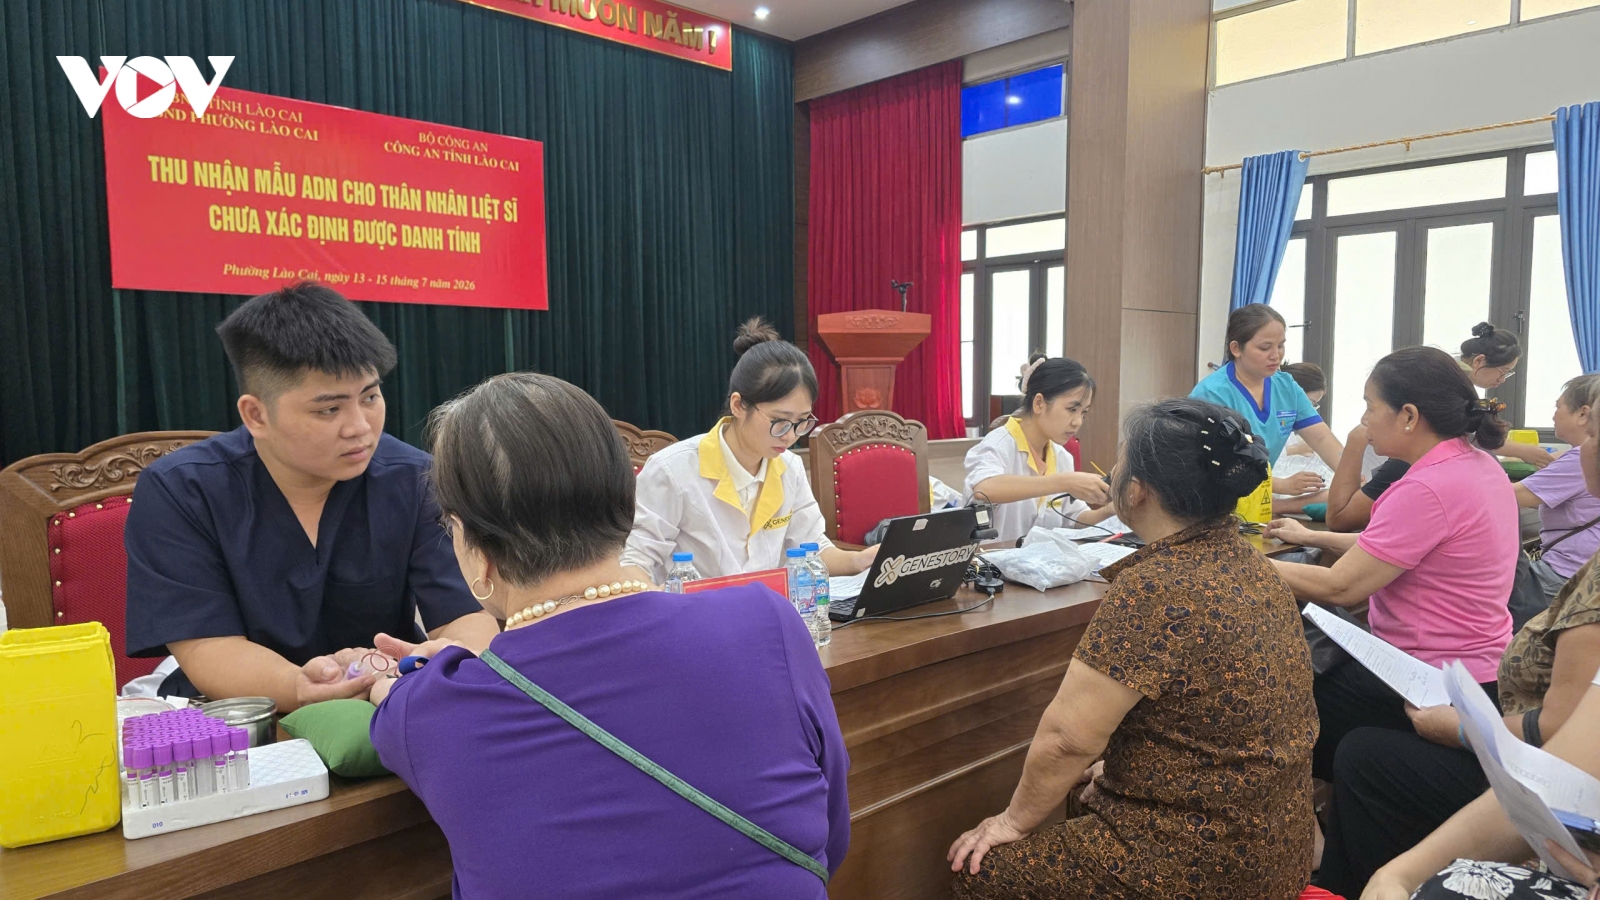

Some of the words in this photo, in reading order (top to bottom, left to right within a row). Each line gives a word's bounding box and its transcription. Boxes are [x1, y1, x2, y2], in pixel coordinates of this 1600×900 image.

[643, 10, 704, 51] NĂM
[246, 102, 276, 119] LÀO
[278, 108, 303, 123] CAI
[260, 121, 291, 137] LÀO
[293, 127, 319, 141] CAI
[418, 131, 436, 145] BỘ
[437, 134, 470, 150] CÔNG
[472, 142, 488, 153] AN
[383, 139, 420, 157] CÔNG
[423, 148, 440, 159] AN
[442, 149, 471, 164] TỈNH
[474, 154, 498, 168] LÀO
[500, 159, 520, 172] CAI
[148, 155, 187, 185] THU
[193, 159, 249, 196] NHẬN
[254, 161, 296, 198] MẪU
[301, 175, 338, 202] ADN
[342, 179, 376, 207] CHO
[380, 182, 422, 212] THÂN
[425, 189, 468, 217] NHÂN
[471, 193, 500, 225] LIỆT
[503, 197, 518, 223] SĨ
[208, 204, 261, 234] CHƯA
[265, 207, 302, 238] XÁC
[307, 213, 349, 246] ĐỊNH
[353, 219, 397, 250] ĐƯỢC
[401, 224, 443, 250] DANH
[447, 226, 481, 254] TÍNH
[223, 263, 270, 280] Phường
[272, 266, 295, 279] Lào
[324, 271, 350, 285] ngày
[353, 272, 366, 284] 13
[376, 274, 388, 285] 15
[390, 275, 419, 289] tháng
[421, 277, 428, 288] 7
[429, 278, 451, 289] năm
[453, 279, 476, 291] 2026
[900, 544, 976, 574] GENESTORY
[152, 821, 163, 829] 010
